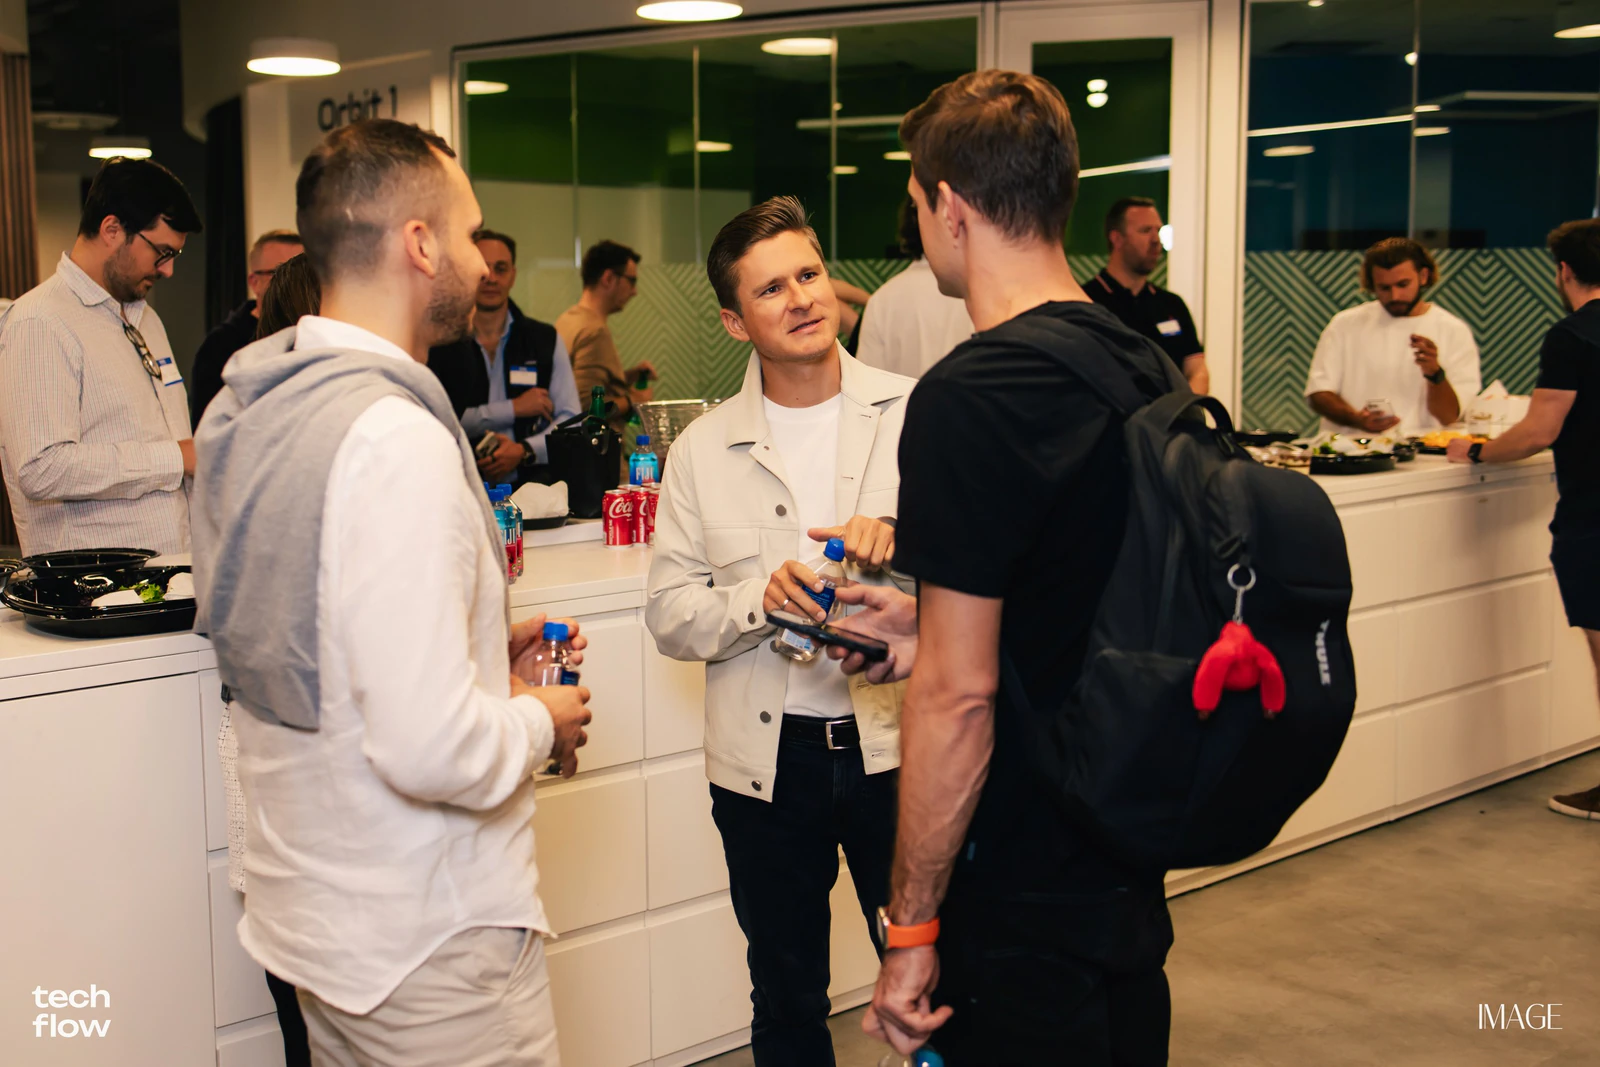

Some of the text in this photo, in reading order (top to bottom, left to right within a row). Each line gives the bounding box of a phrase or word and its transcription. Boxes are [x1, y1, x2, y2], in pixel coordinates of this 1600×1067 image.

[317, 85, 398, 132] Orbit 1
[635, 466, 654, 481] FIJI
